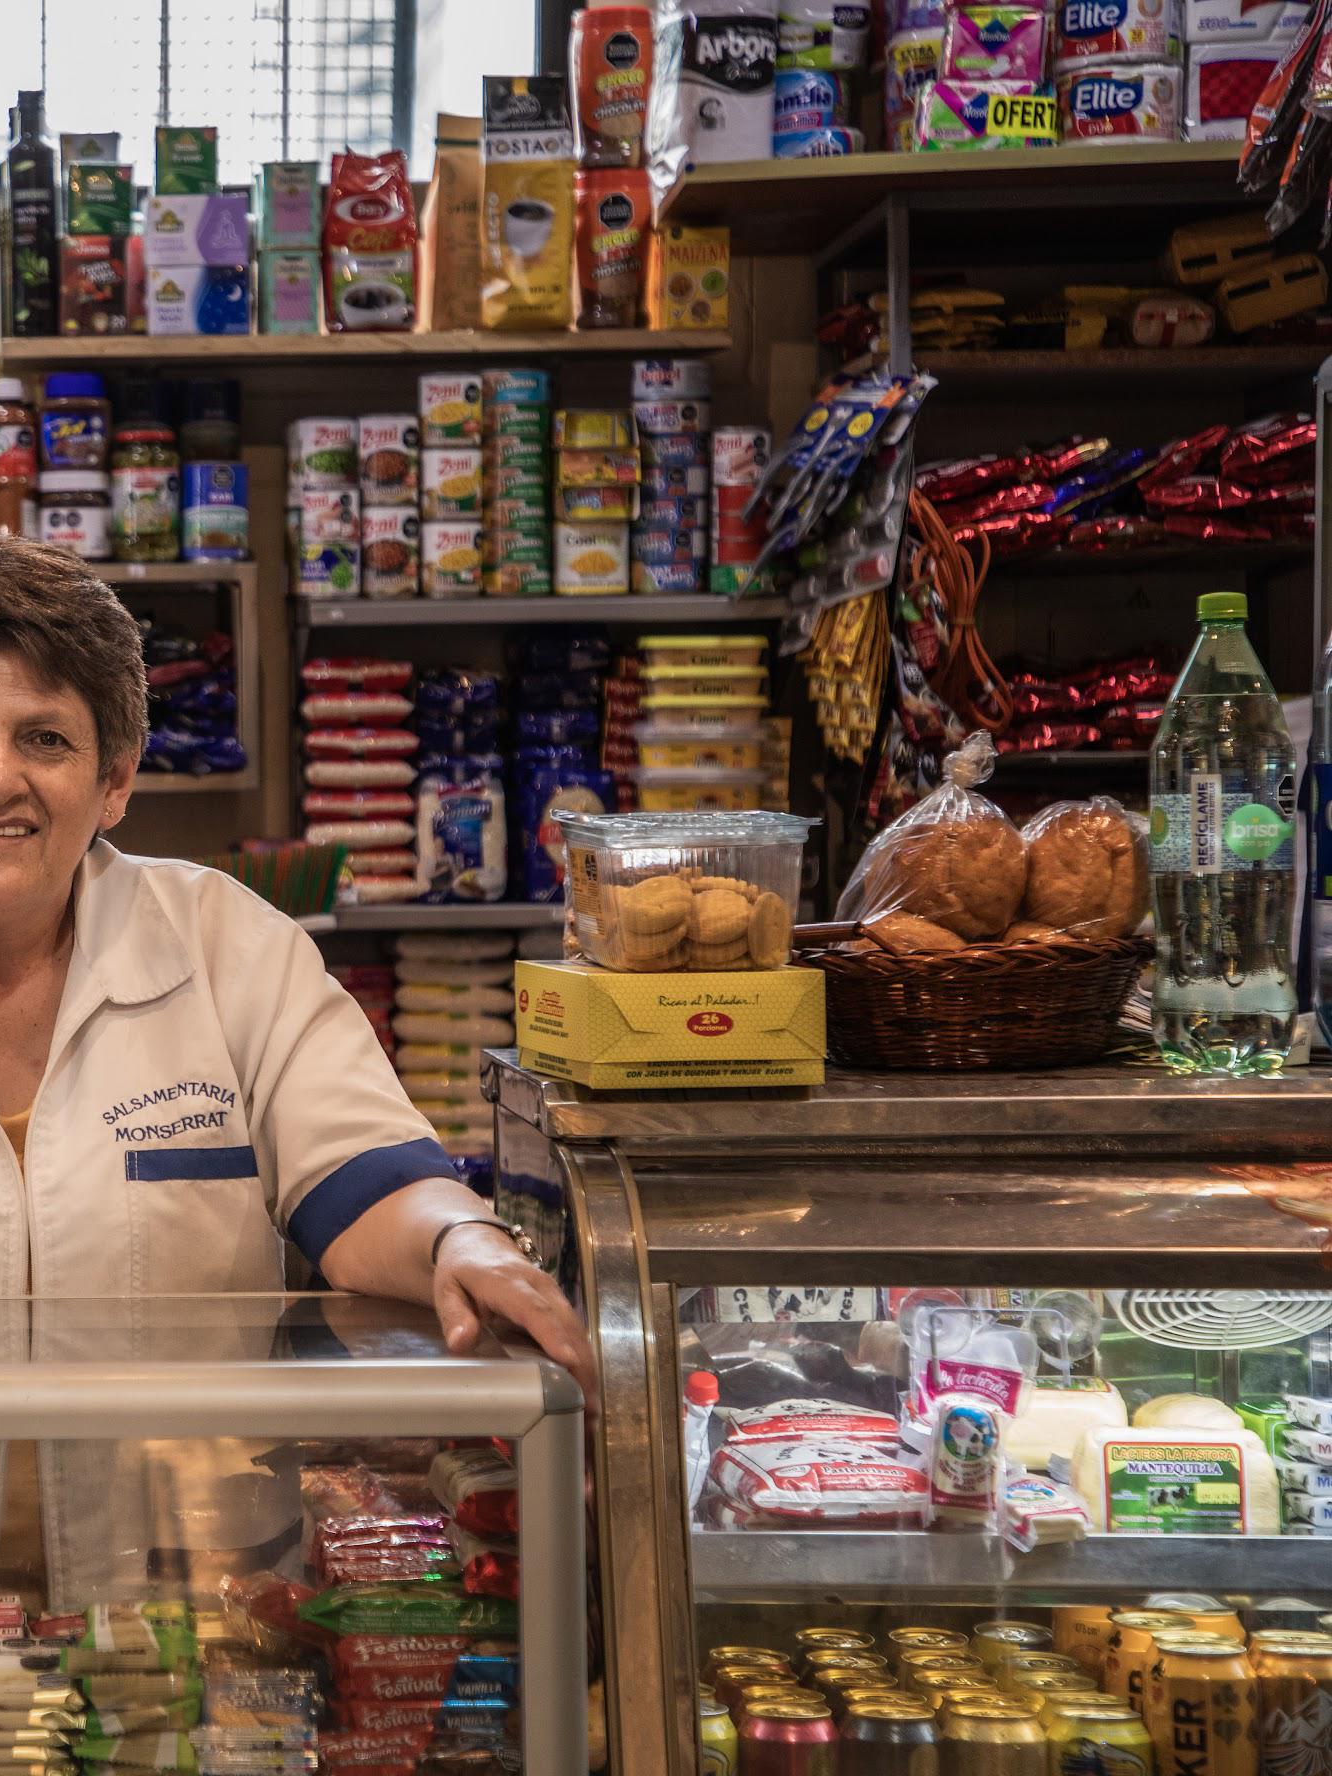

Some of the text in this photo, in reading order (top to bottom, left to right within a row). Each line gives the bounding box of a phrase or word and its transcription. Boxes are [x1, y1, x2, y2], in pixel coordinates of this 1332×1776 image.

[1066, 0, 1120, 31] Elite
[1076, 81, 1136, 111] Elite
[1194, 782, 1209, 866] RECÍCLAME
[1229, 821, 1279, 838] brisa
[693, 1024, 728, 1032] Porciones
[701, 1014, 720, 1025] 26
[102, 1081, 236, 1125] SALSAMENTARIA
[115, 1111, 228, 1142] MONSERRAT
[1112, 1447, 1236, 1462] LACTEOS LA PASTORA
[1127, 1462, 1223, 1476] MANTEQUILLA
[355, 1637, 467, 1661] Festival
[373, 1672, 446, 1699] Festival
[457, 1682, 502, 1697] VAINILLA
[362, 1707, 433, 1731] Festival
[445, 1713, 492, 1728] VAINILLA
